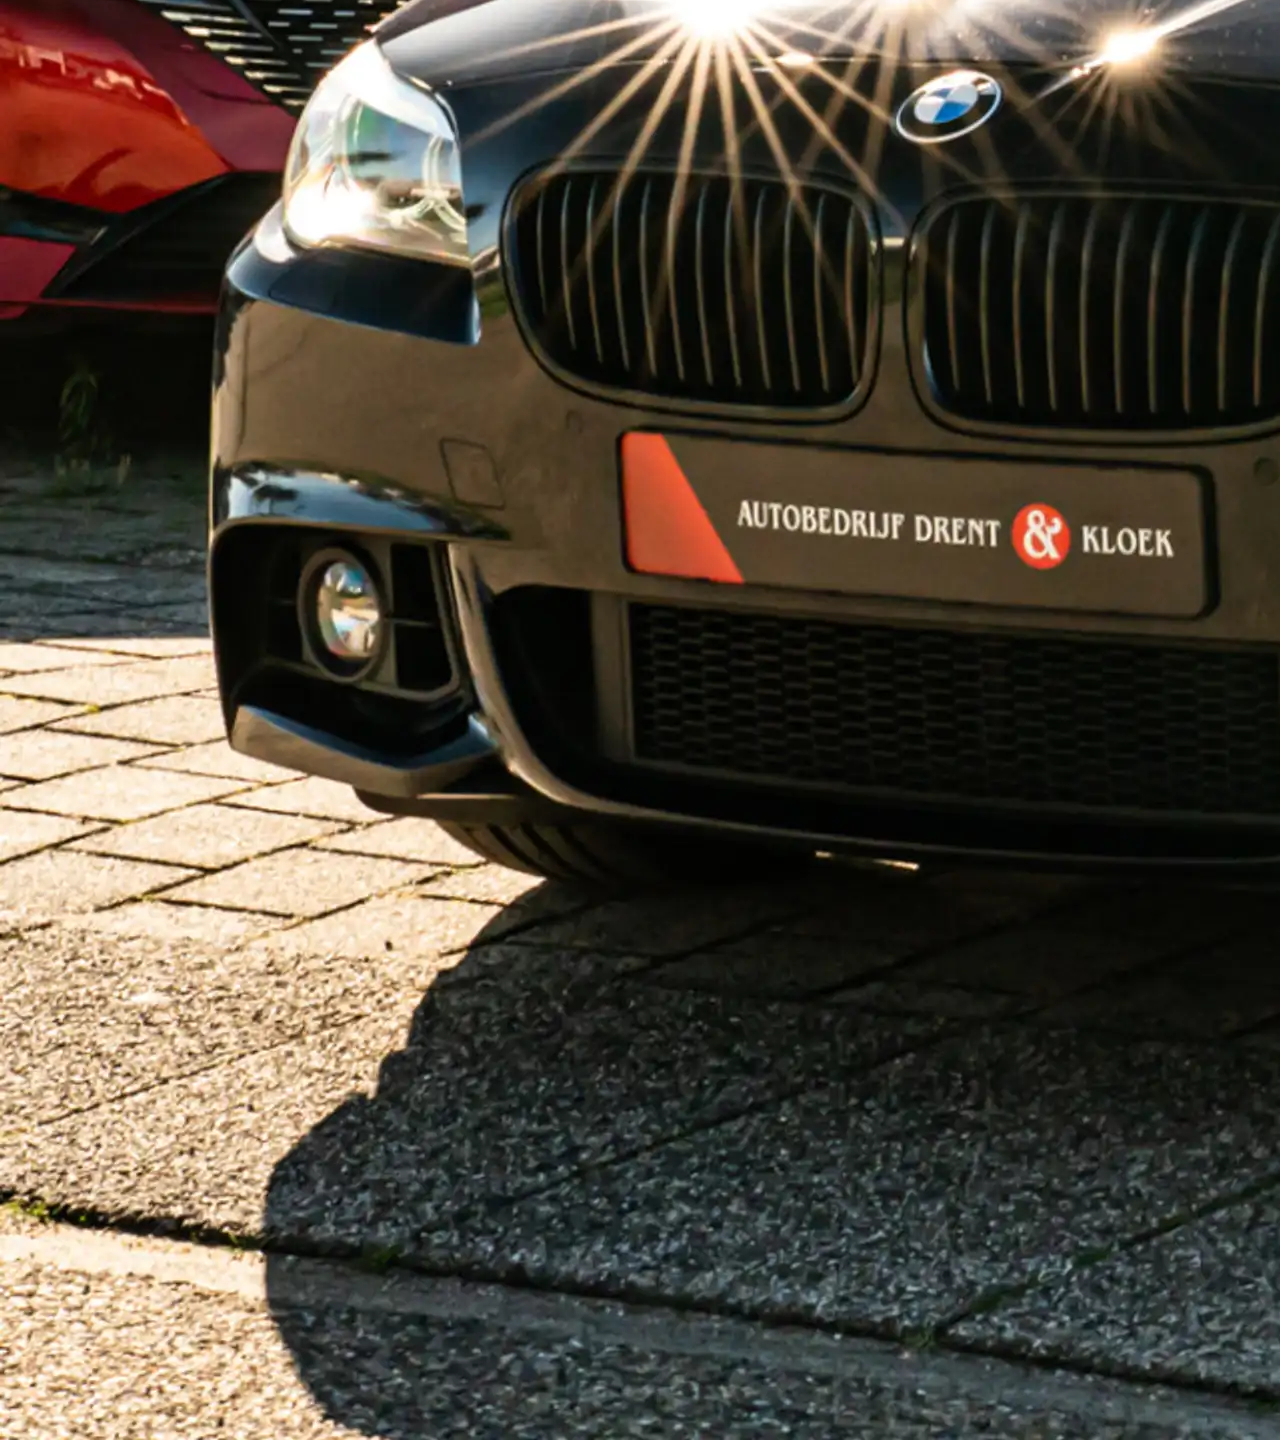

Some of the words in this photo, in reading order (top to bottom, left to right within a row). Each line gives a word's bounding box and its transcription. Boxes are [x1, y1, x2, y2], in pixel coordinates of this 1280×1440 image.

[737, 499, 906, 540] AUTOBEDRIJF
[914, 514, 1001, 548] DRENT
[1022, 509, 1063, 559] &
[1081, 524, 1175, 558] KLOEK
